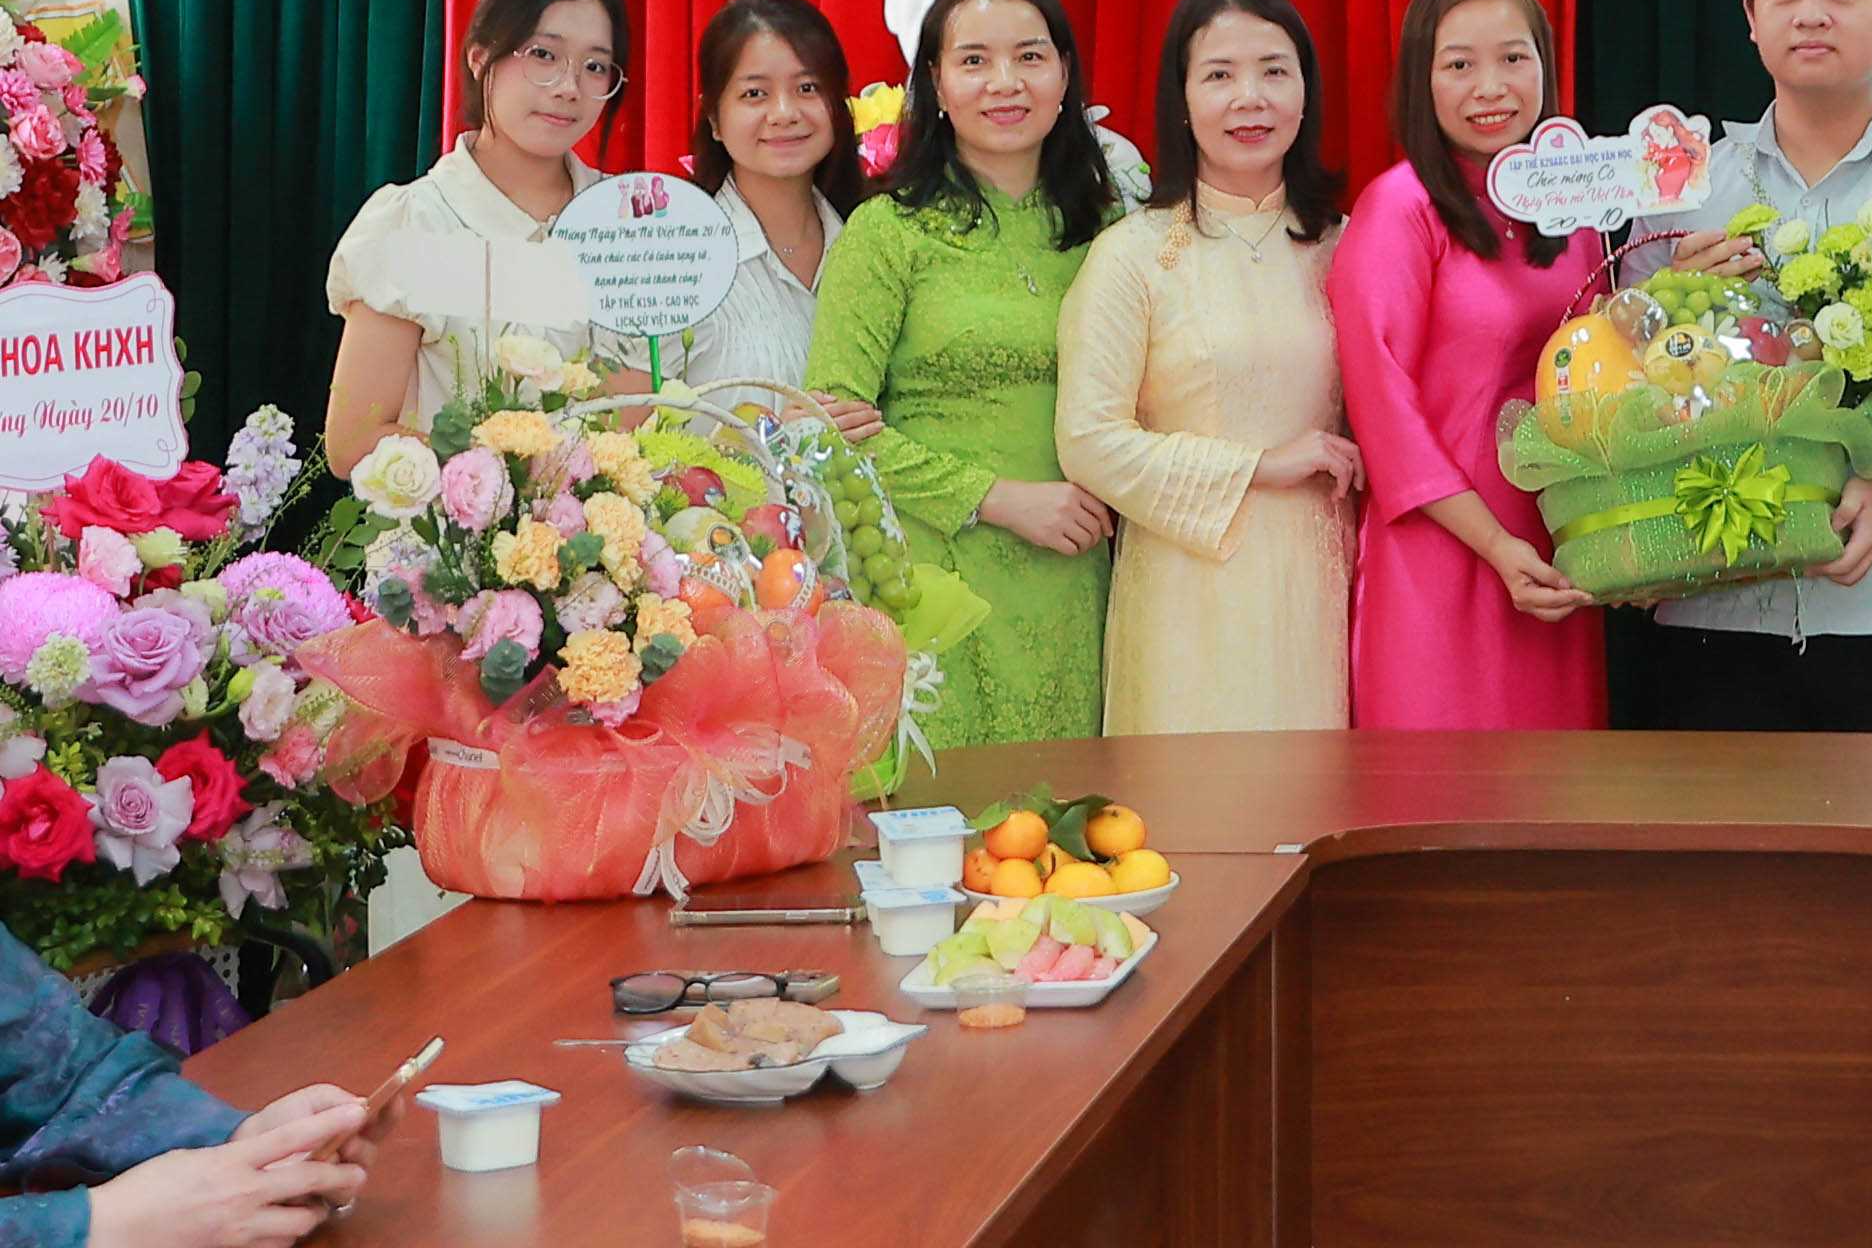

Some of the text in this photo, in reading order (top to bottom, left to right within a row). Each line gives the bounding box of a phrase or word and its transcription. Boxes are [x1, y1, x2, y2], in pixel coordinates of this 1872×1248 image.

[1599, 206, 1624, 227] 10
[1, 325, 154, 377] HOA KHXH
[33, 399, 93, 434] Ngày
[100, 392, 159, 428] 20/10
